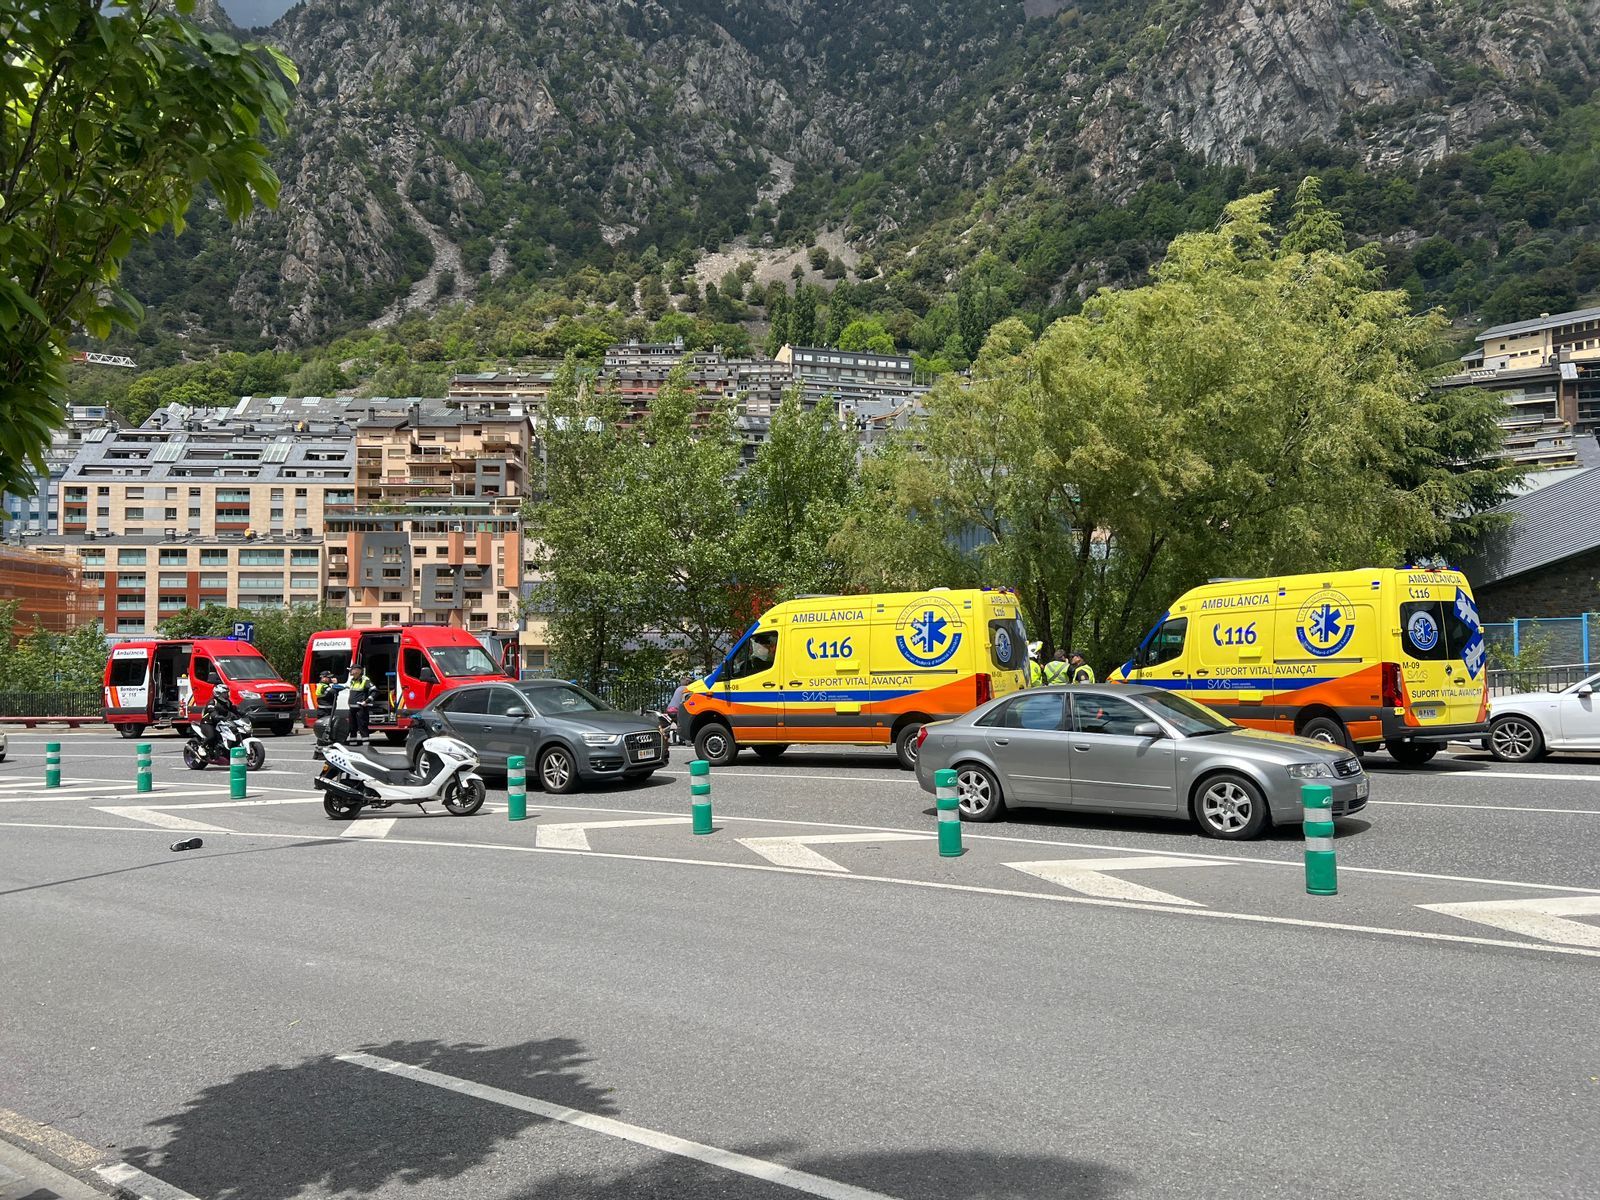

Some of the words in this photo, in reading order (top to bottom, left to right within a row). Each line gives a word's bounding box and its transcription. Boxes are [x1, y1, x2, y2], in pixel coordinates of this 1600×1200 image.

[1415, 587, 1430, 598] 116
[1201, 594, 1270, 609] AMBULÀNCIA
[792, 609, 864, 623] AMBULÀNCIA
[235, 623, 245, 636] P
[1225, 621, 1257, 645] 116
[819, 636, 853, 659] 116
[1215, 667, 1248, 676] SUPORT
[1249, 666, 1273, 675] VITAL
[1275, 665, 1318, 676] AVANÇAT
[809, 677, 844, 687] SUPORT
[845, 676, 868, 686] VITAL
[871, 675, 914, 687] AVANÇAT
[1411, 690, 1440, 698] SUPORT
[1441, 689, 1457, 697] VITAL
[1459, 688, 1482, 697] AVANÇAT
